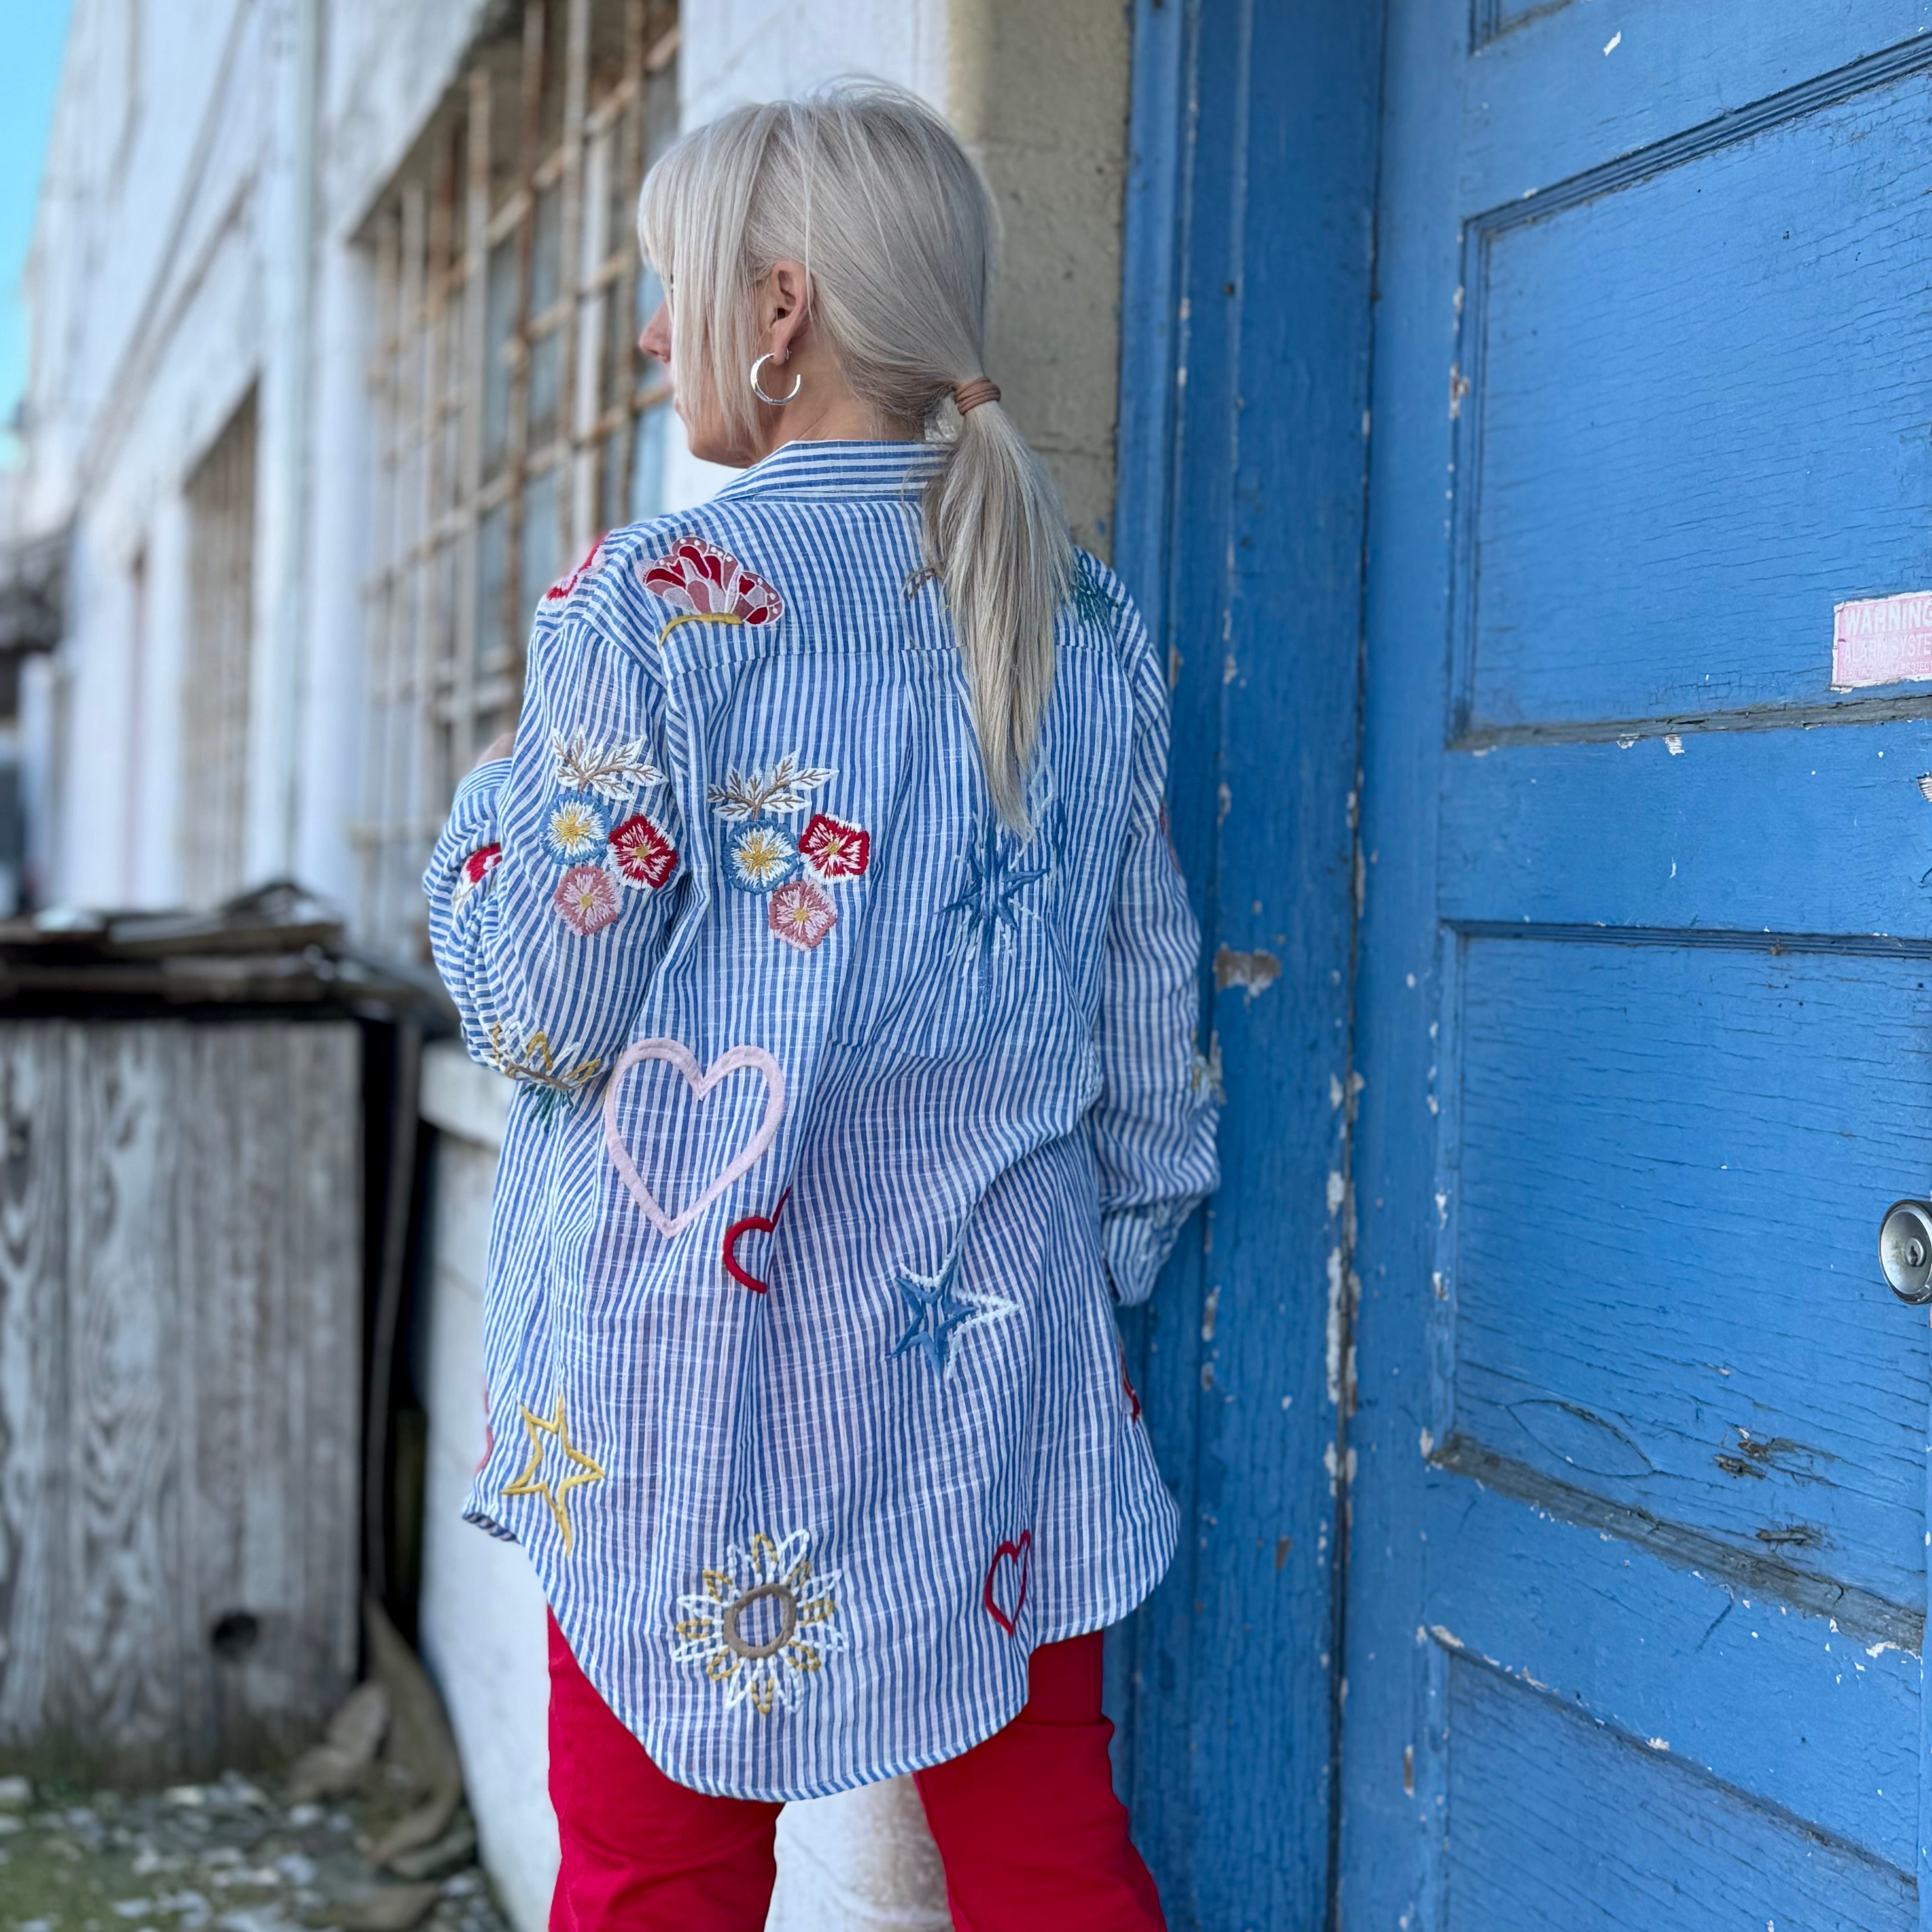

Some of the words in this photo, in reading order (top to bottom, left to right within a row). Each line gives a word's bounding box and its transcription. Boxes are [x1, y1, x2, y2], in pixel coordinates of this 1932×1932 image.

[1844, 599, 1932, 636] WARNING
[1844, 636, 1887, 665] ALARM
[1891, 633, 1932, 658] SYSTE
[1901, 660, 1932, 672] PROTEC
